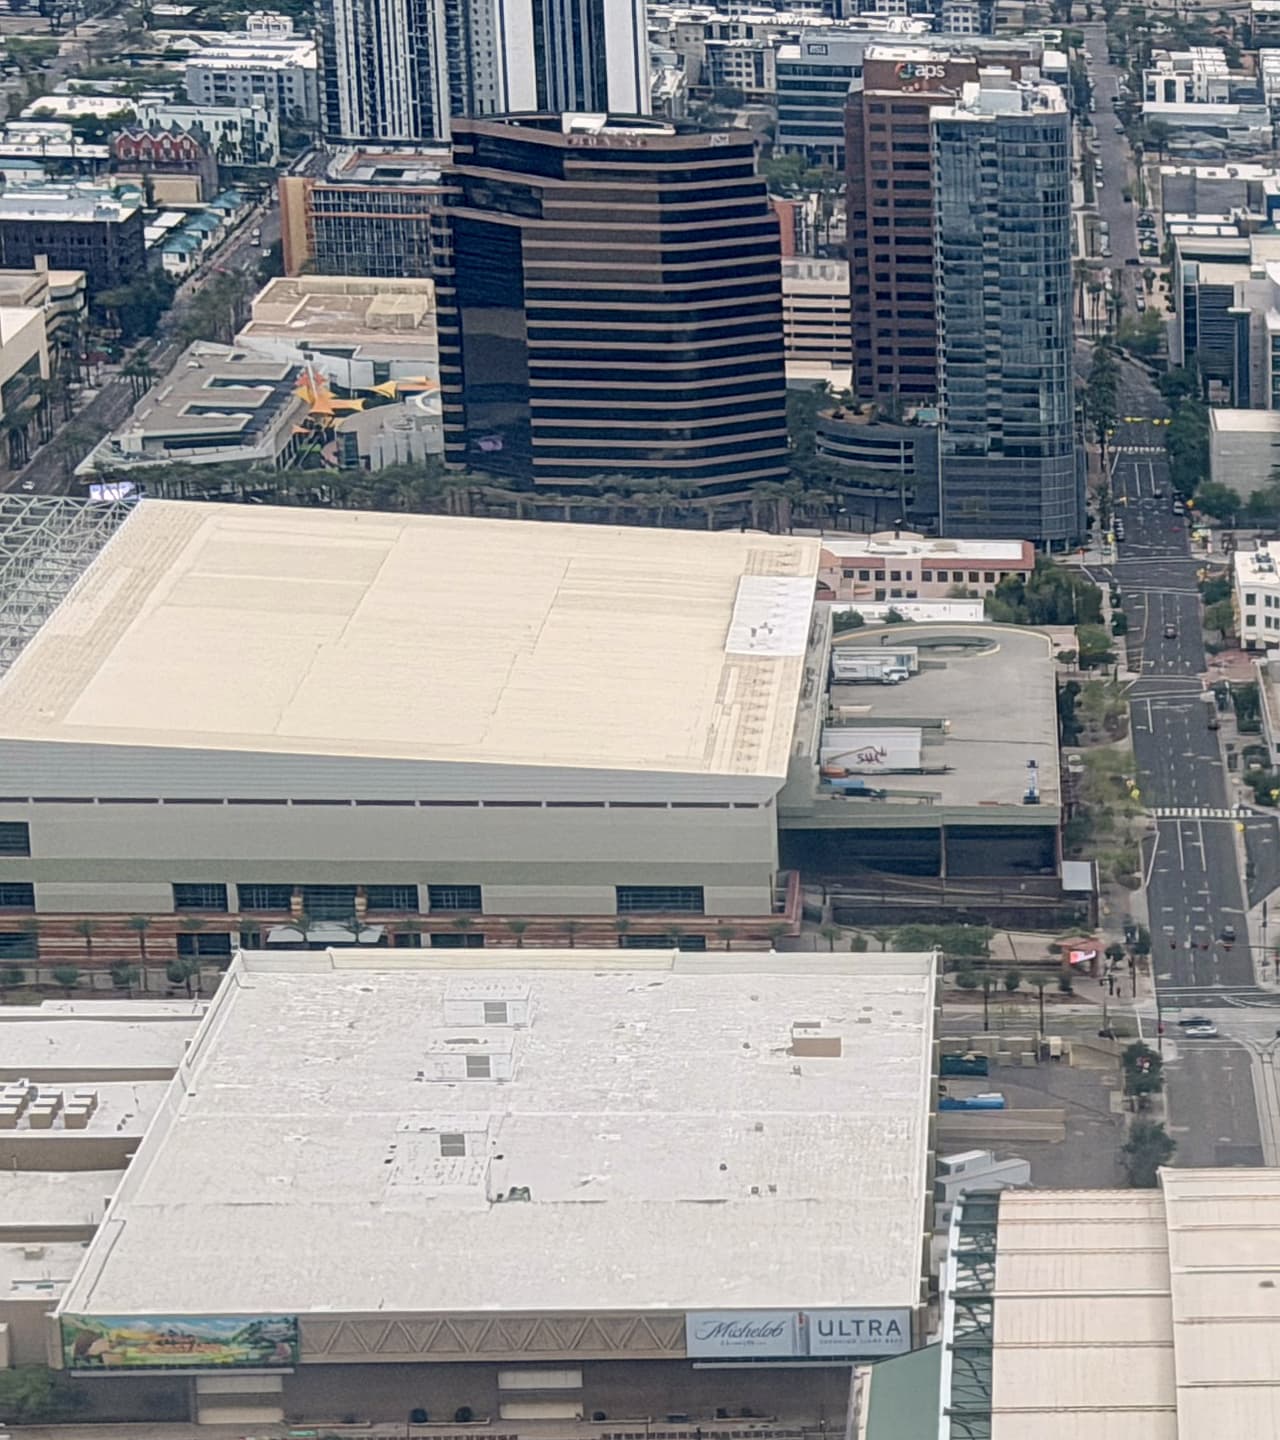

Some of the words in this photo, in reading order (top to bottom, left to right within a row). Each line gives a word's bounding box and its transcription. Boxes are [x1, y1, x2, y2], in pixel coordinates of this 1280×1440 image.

[915, 64, 946, 80] aps
[695, 1320, 787, 1340] Michelob
[818, 1319, 901, 1337] ULTRA
